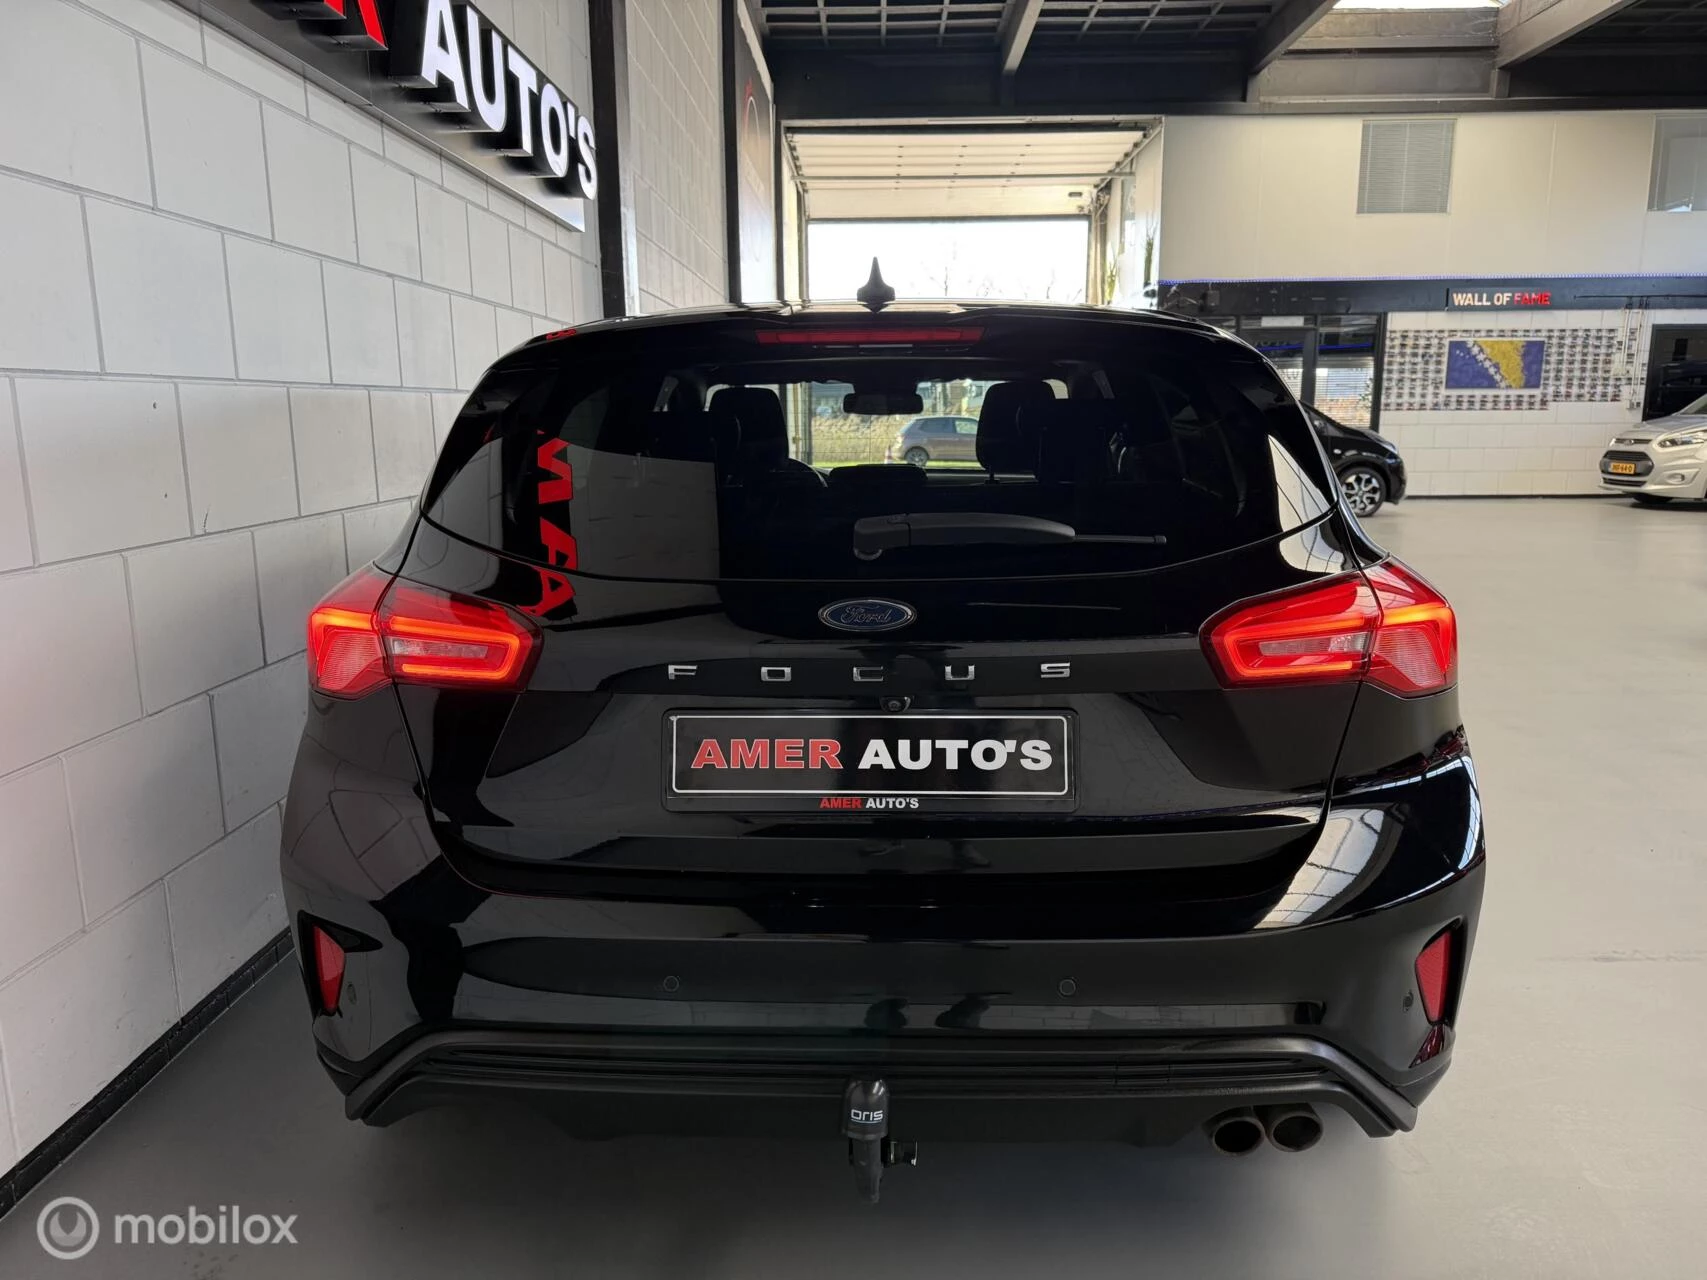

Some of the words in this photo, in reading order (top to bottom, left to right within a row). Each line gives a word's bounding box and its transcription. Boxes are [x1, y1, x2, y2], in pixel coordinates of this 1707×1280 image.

[420, 0, 598, 200] AUTO'S
[1453, 292, 1491, 306] WALL
[1493, 292, 1512, 306] OF
[1513, 291, 1552, 306] FAME
[840, 604, 893, 624] Ford
[668, 662, 1071, 682] FOCUS
[690, 738, 844, 770] AMER
[858, 738, 1053, 771] AUTO'S
[820, 798, 862, 809] AMER
[865, 797, 920, 809] AUTO'S
